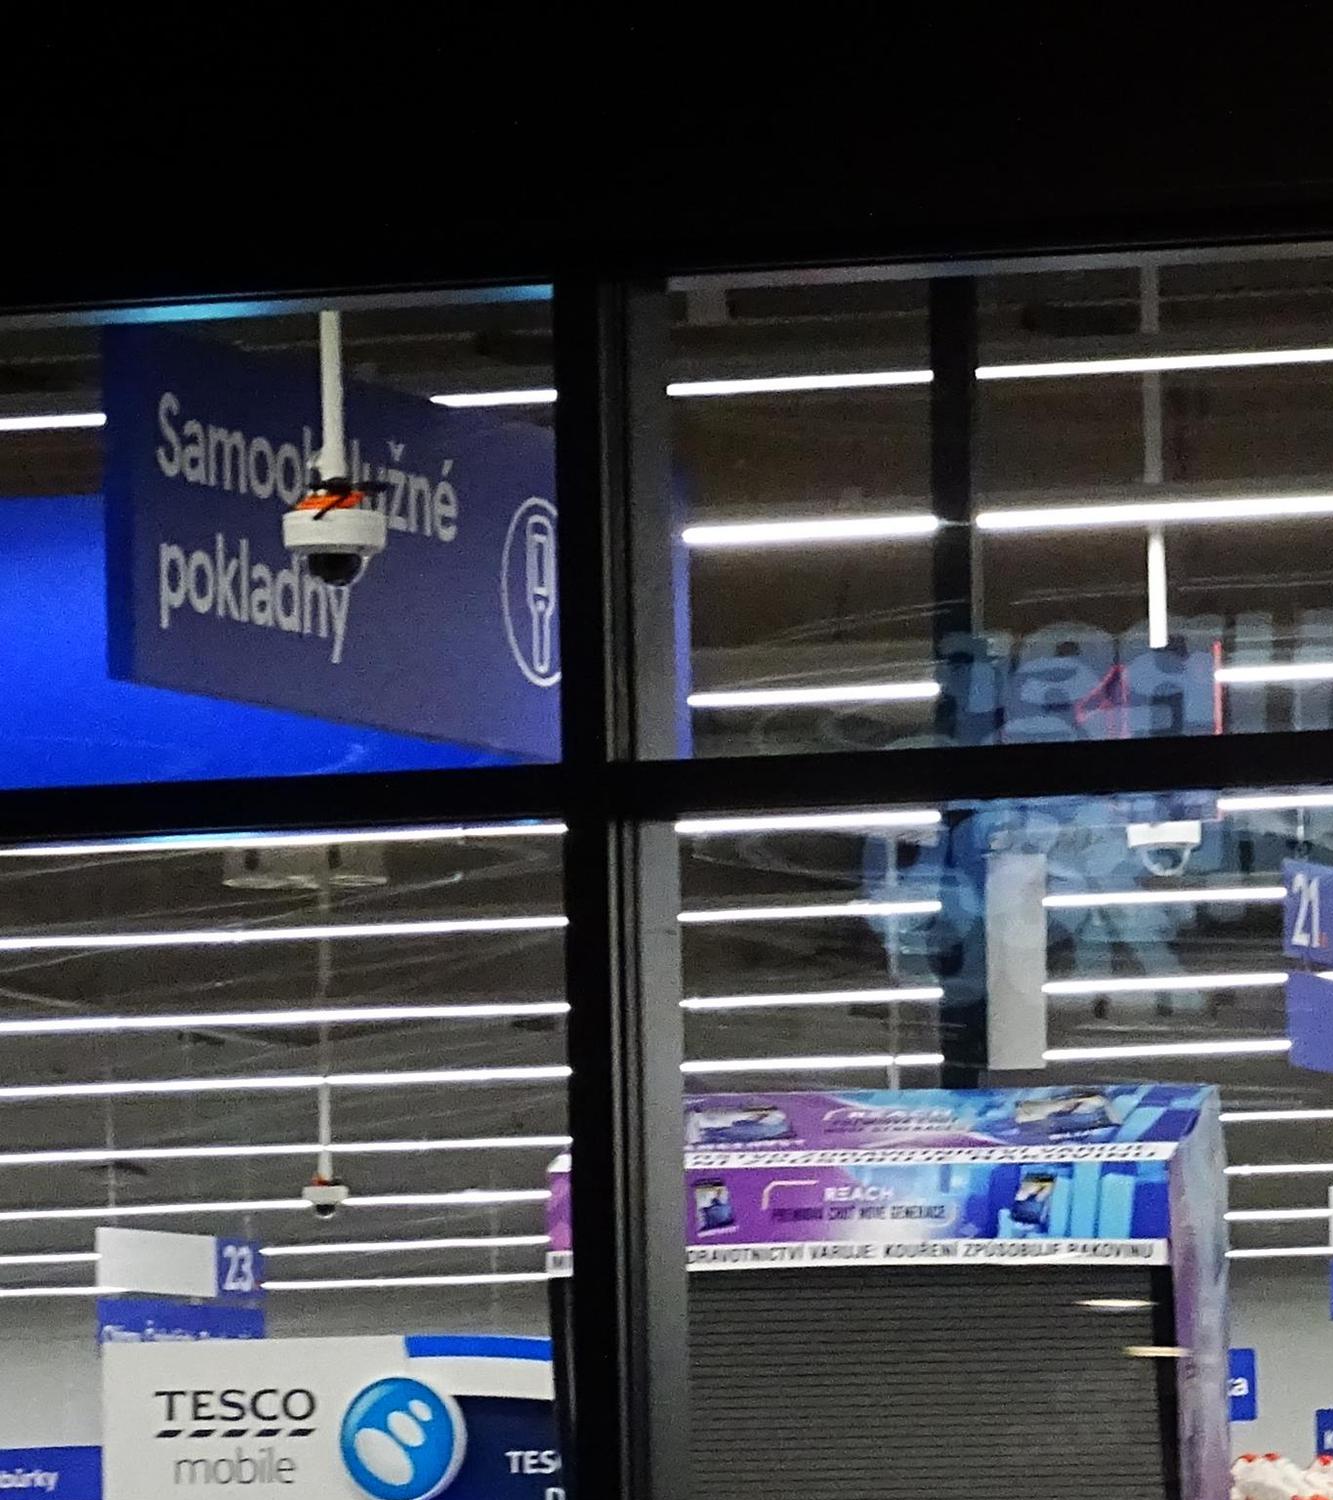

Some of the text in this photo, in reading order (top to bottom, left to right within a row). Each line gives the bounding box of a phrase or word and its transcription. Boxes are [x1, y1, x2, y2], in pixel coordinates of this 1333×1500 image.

[160, 532, 353, 664] pokladny
[1291, 872, 1321, 948] 21
[222, 1244, 255, 1292] 23
[687, 1245, 804, 1264] DRAVOTNICTVÍ
[154, 1388, 316, 1421] TESCO
[173, 1446, 297, 1485] mobile
[504, 1450, 562, 1475] TES
